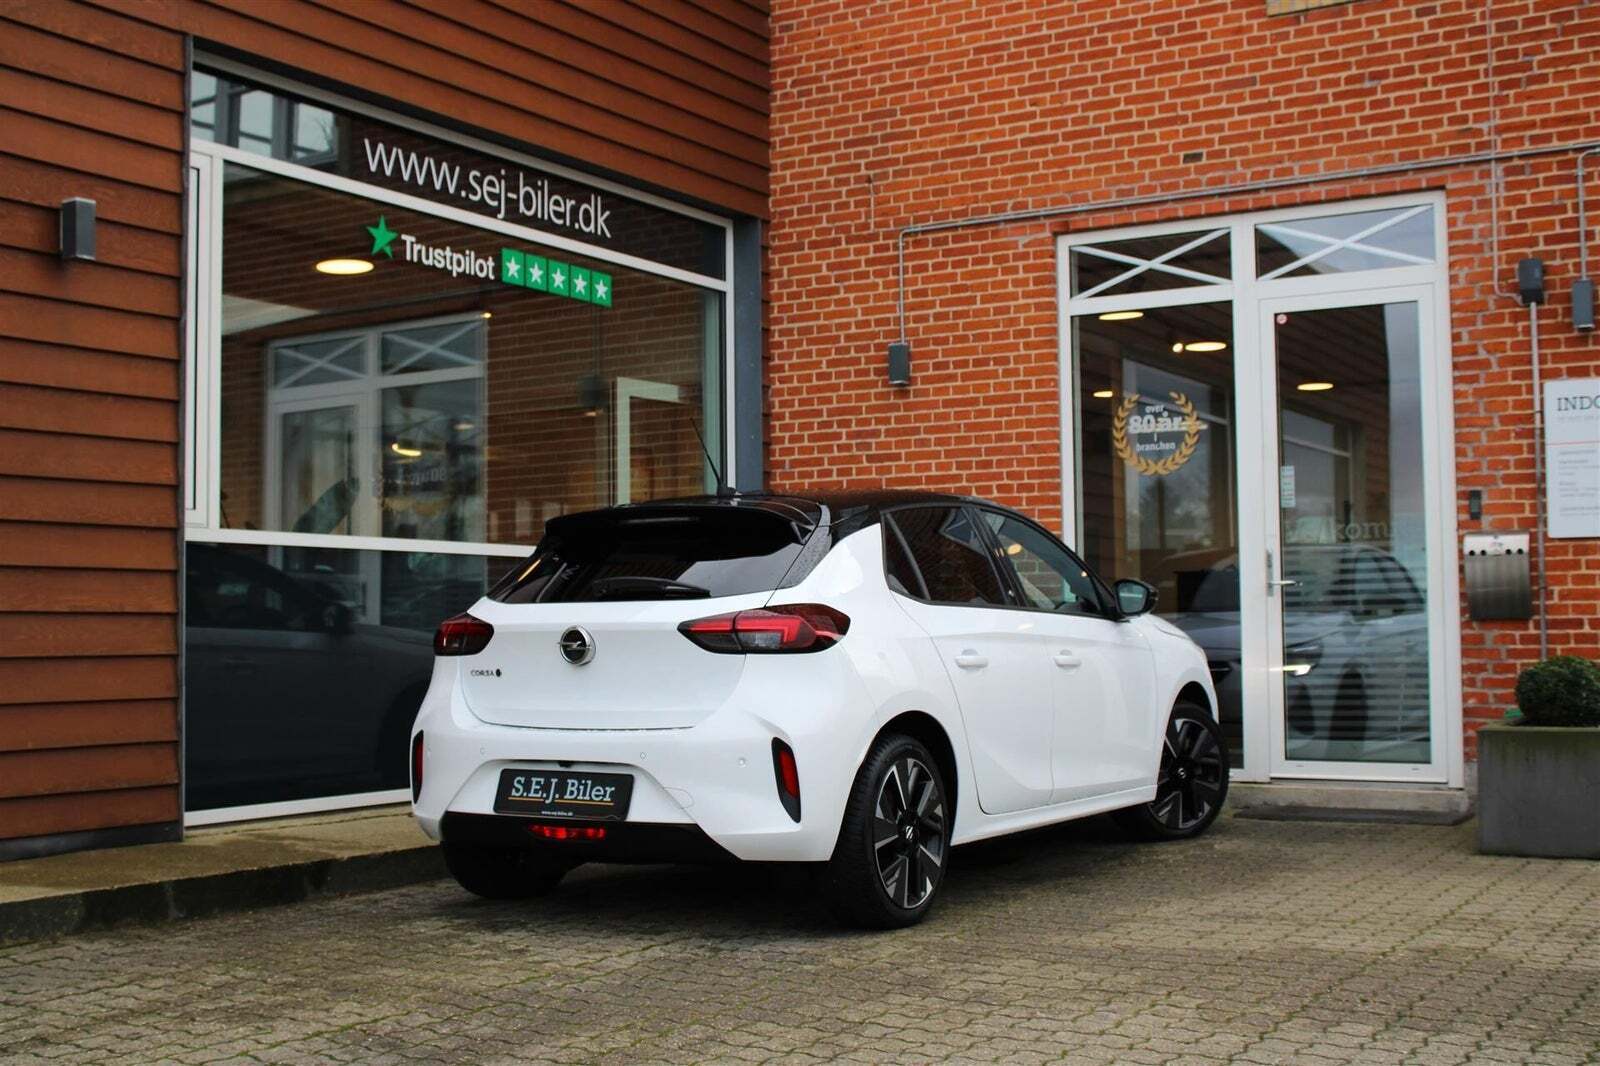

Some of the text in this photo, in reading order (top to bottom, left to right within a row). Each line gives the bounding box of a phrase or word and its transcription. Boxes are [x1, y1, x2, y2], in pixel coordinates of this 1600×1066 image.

[364, 138, 612, 238] www.sej-biler.dk
[401, 234, 495, 280] Trustpilot
[1129, 415, 1155, 433] 80
[511, 776, 615, 804] S.E.J. Biler
